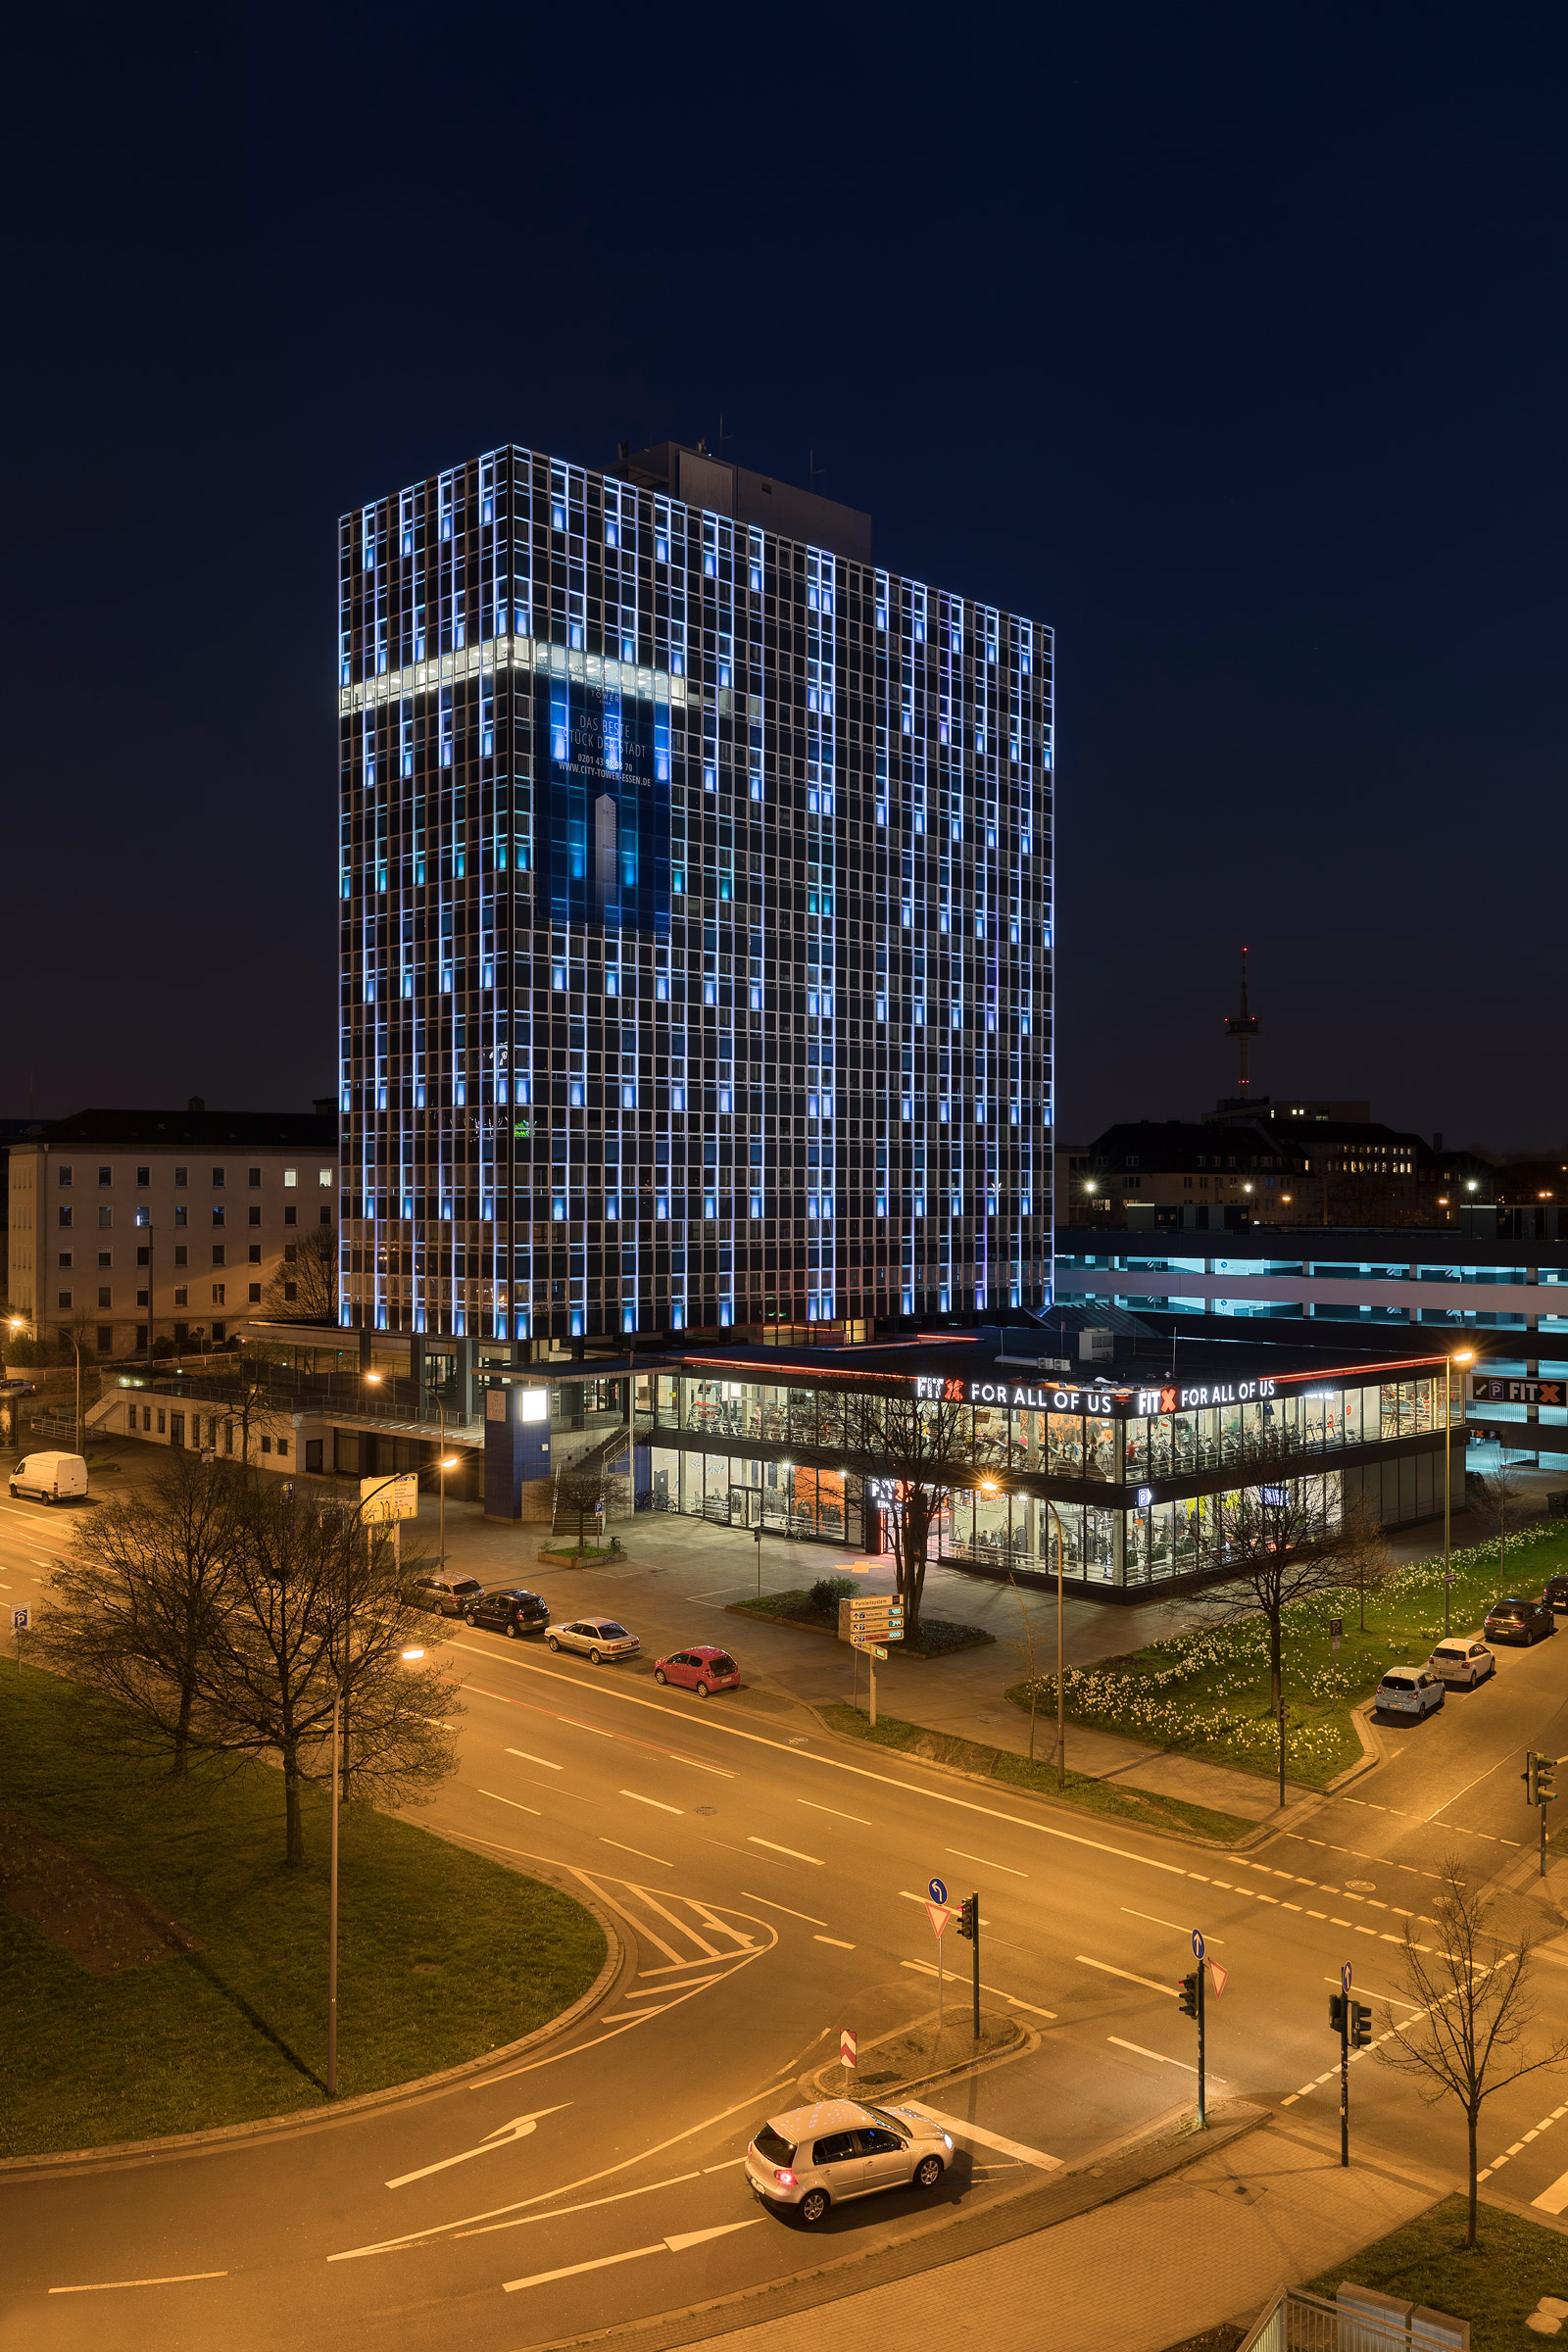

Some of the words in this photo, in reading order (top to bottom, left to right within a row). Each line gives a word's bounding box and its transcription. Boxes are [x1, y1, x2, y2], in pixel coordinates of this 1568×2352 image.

[591, 690, 619, 703] TOWER
[579, 714, 599, 731] DAS
[602, 719, 630, 738] BESTE
[563, 728, 594, 747] STÜCK
[597, 735, 615, 753] DER
[618, 739, 647, 759] STADT
[577, 753, 594, 764] 0201
[595, 757, 604, 766] 43
[624, 762, 633, 772] 70
[558, 761, 652, 787] WWW.CITY-TOWER-ESSEN.DE
[917, 1376, 964, 1401] FITX
[971, 1383, 1007, 1403] FOR
[1013, 1389, 1048, 1407] ALL
[1054, 1391, 1080, 1410] OF
[1087, 1395, 1112, 1413] US
[1138, 1388, 1176, 1415] FITX
[1181, 1388, 1208, 1407] FOR
[1211, 1384, 1235, 1403] ALL
[1238, 1381, 1256, 1400] OF
[1259, 1379, 1275, 1397] US
[1509, 1382, 1560, 1403] FITX
[1470, 1429, 1484, 1438] TX
[17, 1615, 25, 1627] P
